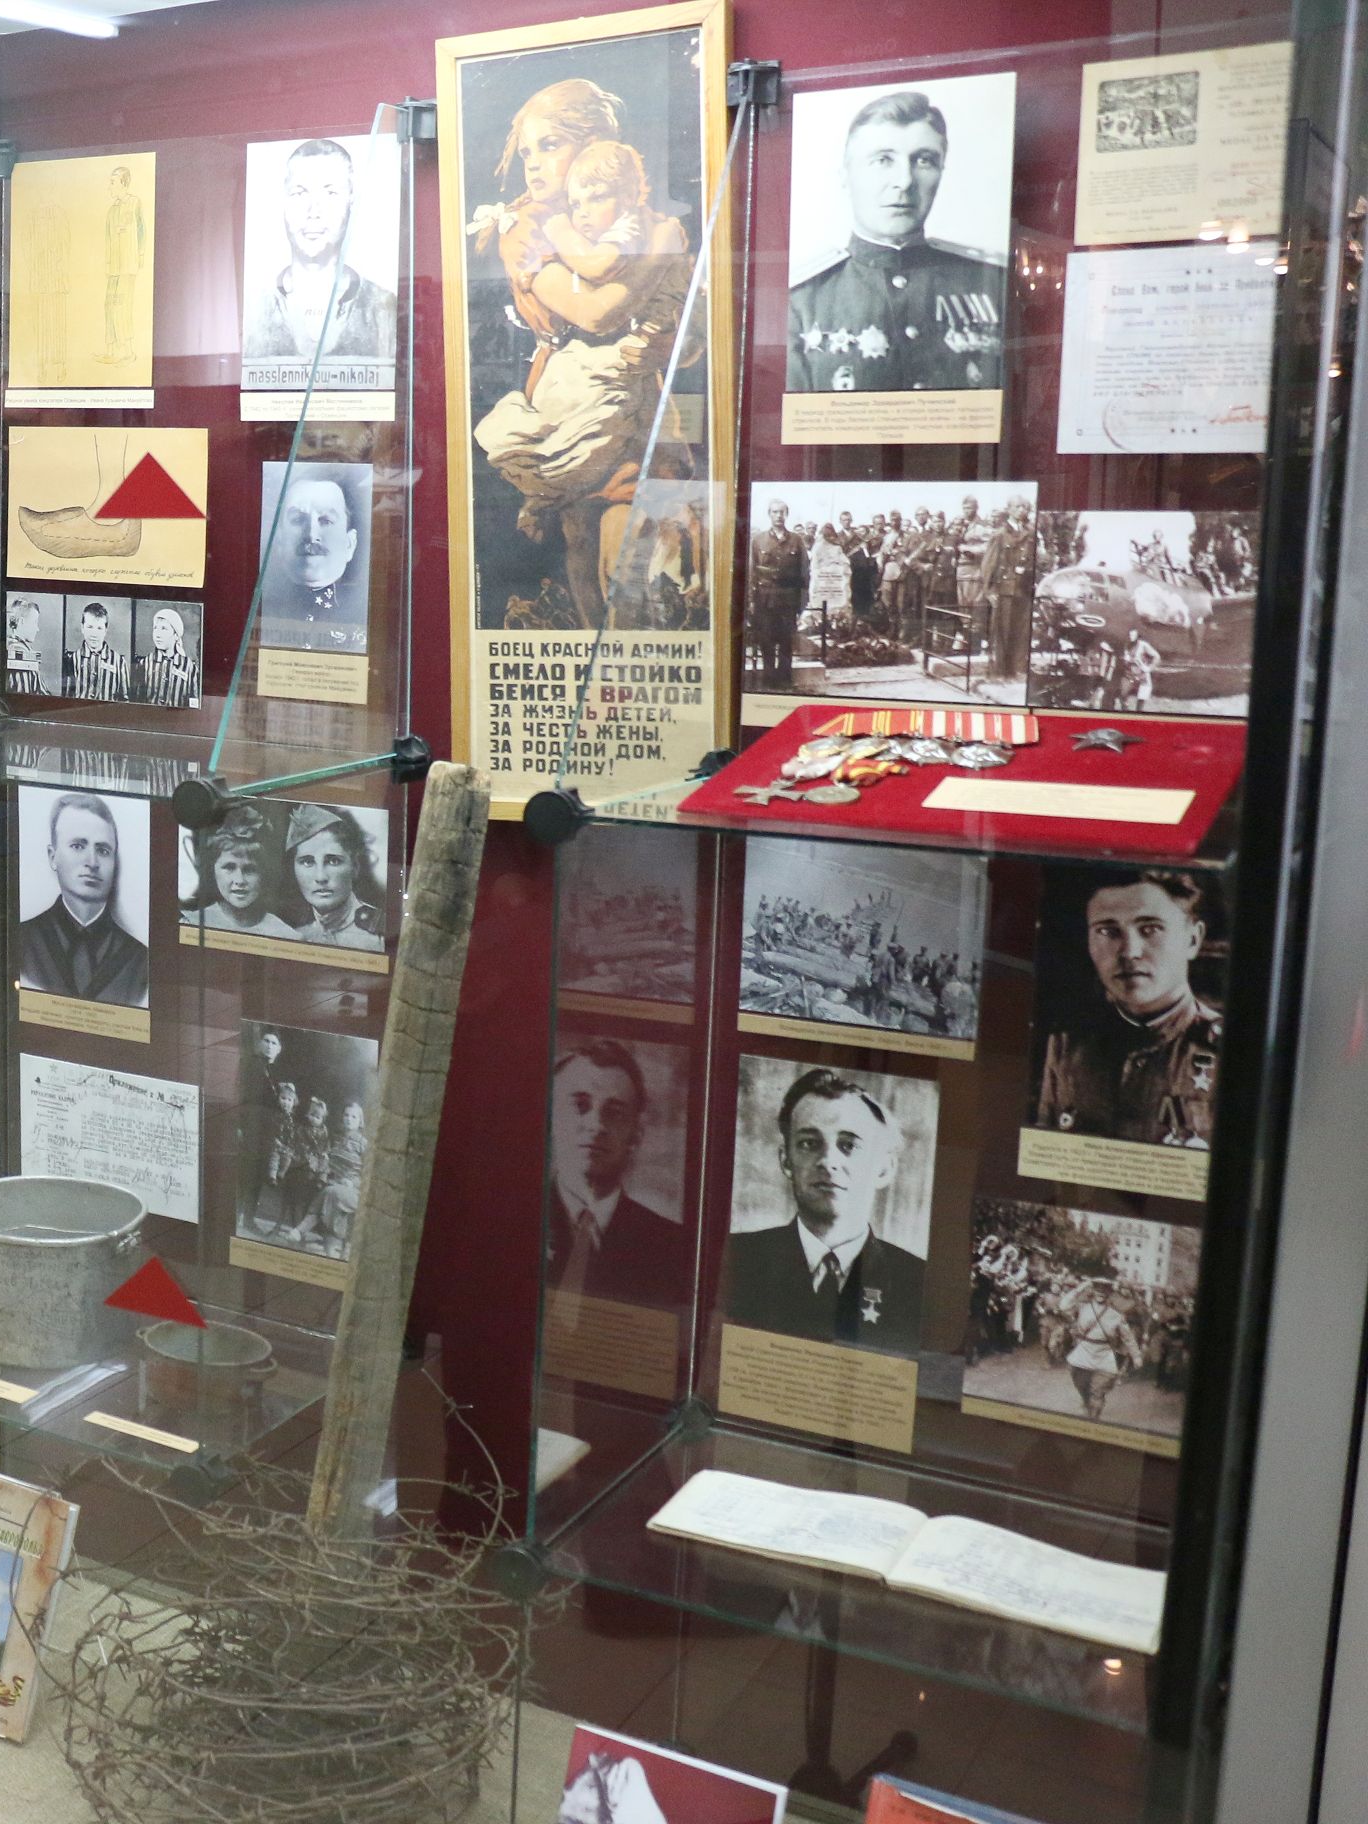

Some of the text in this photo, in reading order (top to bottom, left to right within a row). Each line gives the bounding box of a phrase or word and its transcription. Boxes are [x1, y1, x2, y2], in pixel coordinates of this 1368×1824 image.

[489, 640, 702, 659] БОЕЦ КРАСНОЙ АРМИИ!
[490, 663, 566, 680] СМЕЛО
[600, 662, 702, 683] СТОЙКО
[490, 682, 566, 702] БЕЙСЯ
[600, 685, 702, 704] ВРАГОМ
[490, 703, 512, 718] ЗА
[523, 704, 597, 721] ЖИЗНЬ
[490, 721, 512, 737] ЗА
[523, 722, 588, 739] ЧЕСТЬ
[490, 739, 512, 754] ЗА
[523, 740, 606, 757] РОДНОЙ
[490, 757, 614, 776] ЗА РОДИНУ!
